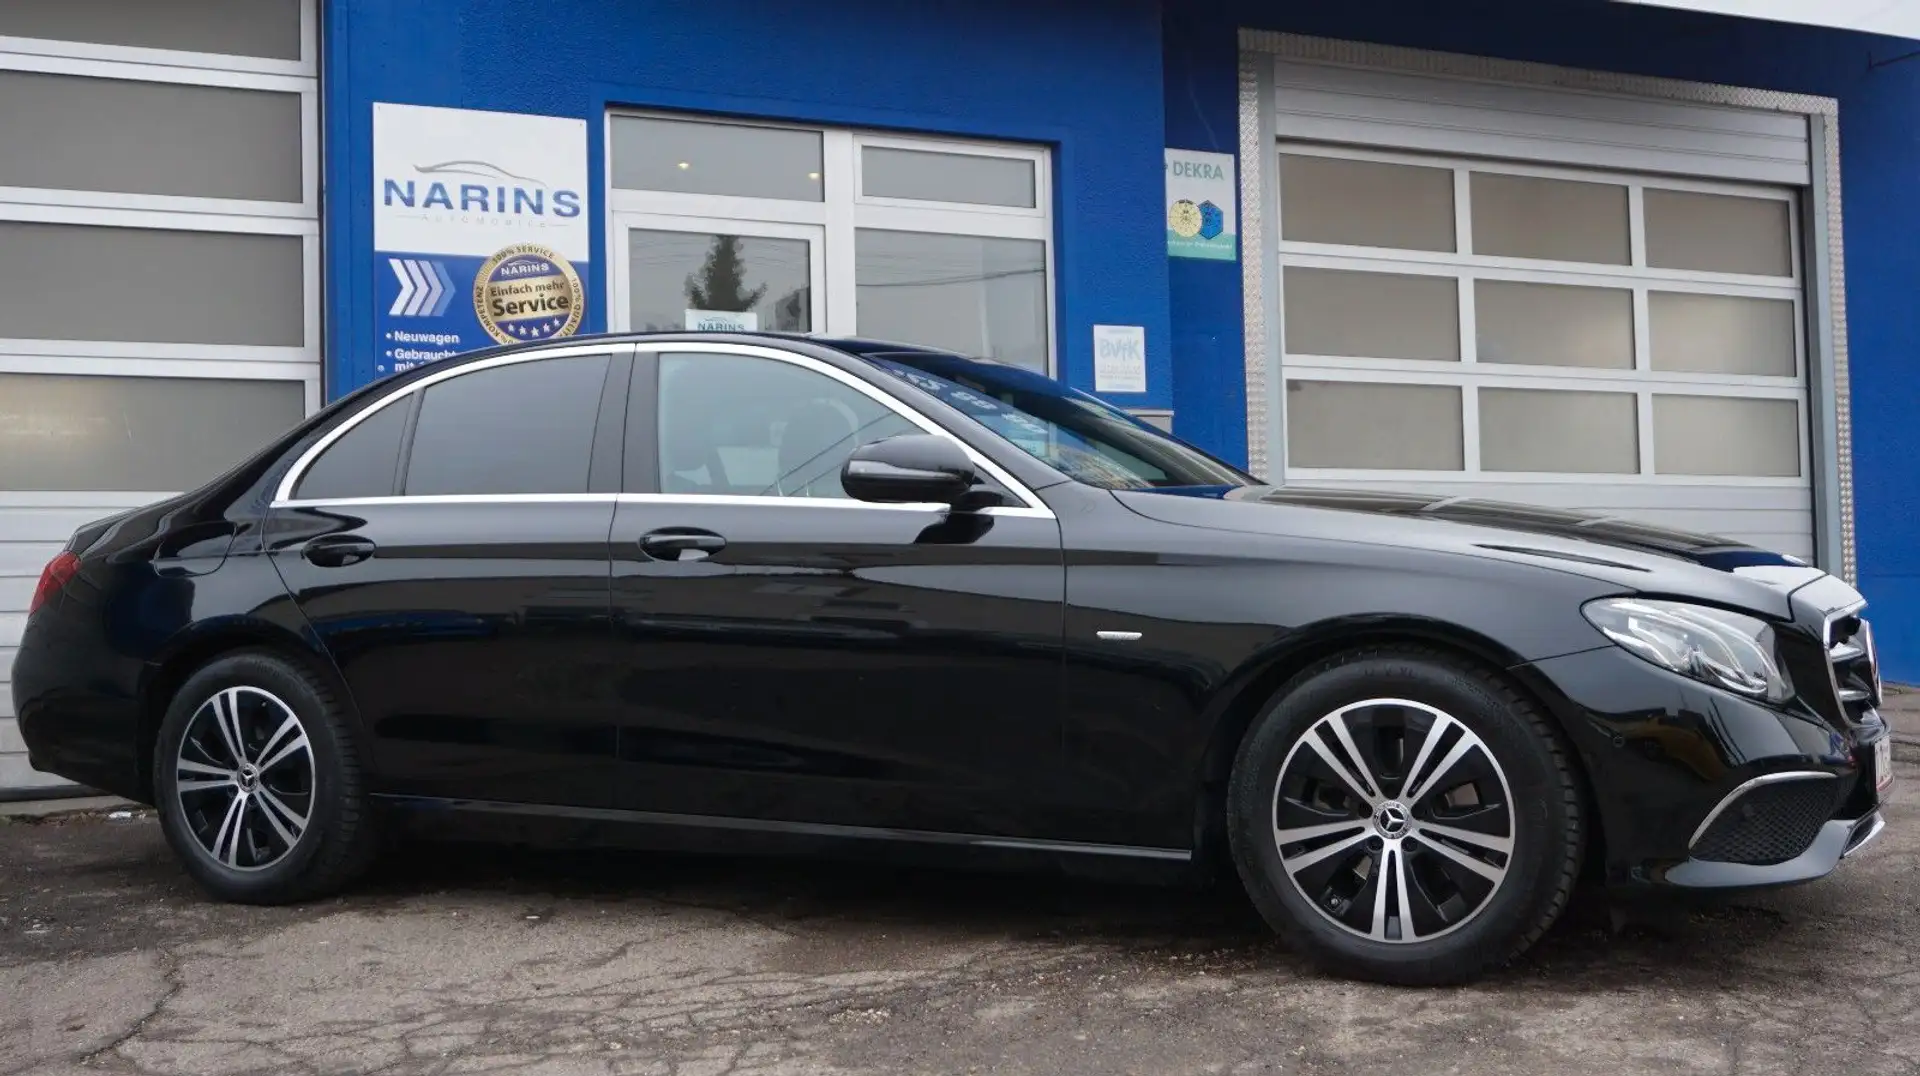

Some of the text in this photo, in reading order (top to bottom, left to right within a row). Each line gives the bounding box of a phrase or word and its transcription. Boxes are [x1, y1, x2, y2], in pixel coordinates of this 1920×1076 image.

[1173, 161, 1224, 180] DEKRA
[384, 178, 581, 218] NARINS
[516, 245, 556, 259] SERVICE
[501, 263, 550, 275] NARINS
[490, 280, 564, 297] Einfach mehr
[475, 285, 501, 338] KOMPETENZ
[491, 293, 569, 317] Service
[697, 323, 745, 332] NARINS
[394, 330, 460, 345] Neuwagen
